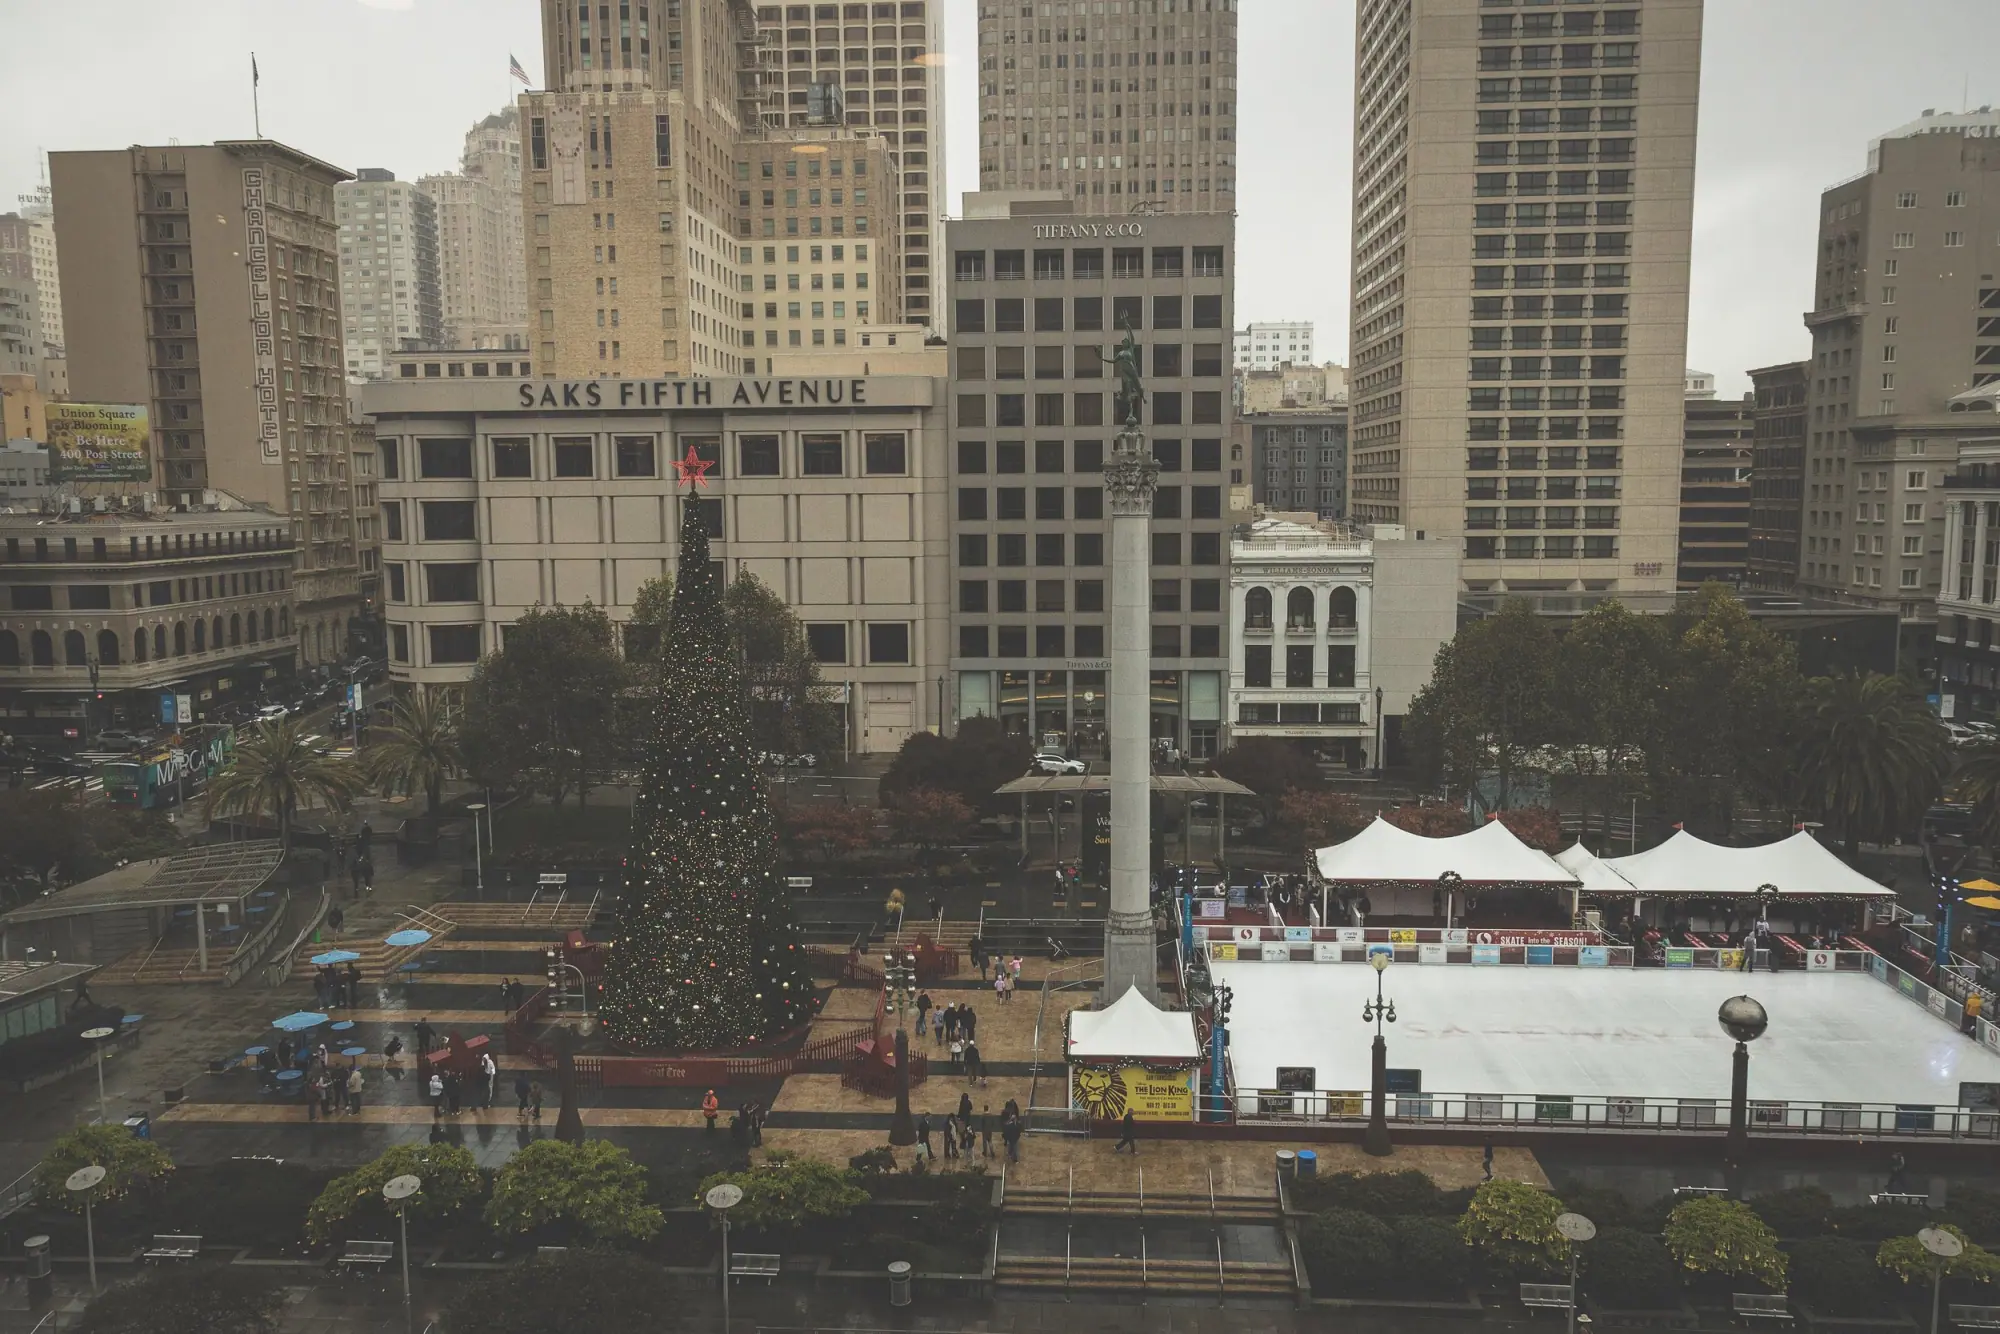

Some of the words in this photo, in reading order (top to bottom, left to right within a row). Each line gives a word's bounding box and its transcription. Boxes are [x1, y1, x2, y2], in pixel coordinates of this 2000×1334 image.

[1033, 224, 1101, 238] TIFFANY
[1105, 224, 1116, 237] &
[1119, 223, 1144, 237] CO.
[245, 170, 273, 356] CHANCELLOR
[519, 383, 601, 407] SAKS
[620, 381, 712, 406] FIFTH
[733, 379, 866, 405] AVENUE
[60, 408, 95, 419] Union
[99, 408, 136, 420] Square
[258, 367, 279, 457] HOTEL
[61, 420, 69, 430] is
[72, 420, 137, 432] Blooming...
[76, 435, 93, 446] Be
[96, 435, 126, 446] Here
[60, 449, 82, 459] 400
[85, 449, 108, 459] Post
[111, 449, 142, 459] Street
[1500, 936, 1525, 946] SKATE
[1528, 936, 1540, 945] into
[1541, 936, 1550, 945] the
[1554, 936, 1588, 946] SEASON!
[1149, 1085, 1167, 1095] LION
[1168, 1085, 1188, 1096] KING
